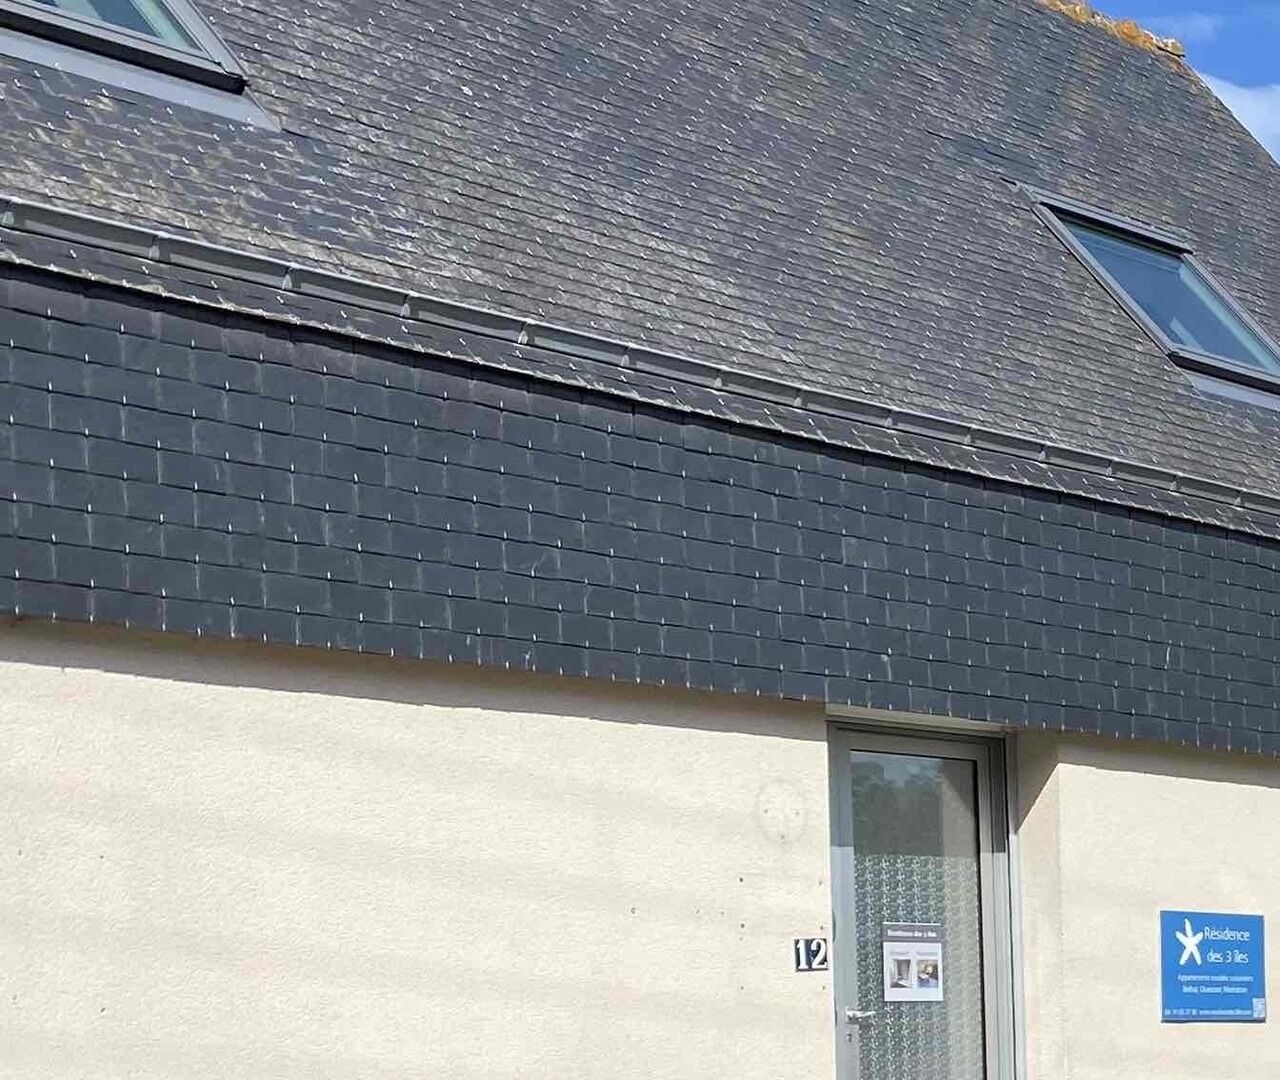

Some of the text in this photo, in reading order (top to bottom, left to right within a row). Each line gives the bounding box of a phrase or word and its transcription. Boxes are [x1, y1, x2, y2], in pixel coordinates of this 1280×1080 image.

[1204, 925, 1250, 941] Résidence
[796, 939, 828, 969] 12
[1207, 949, 1223, 963] des
[1226, 950, 1232, 963] 3
